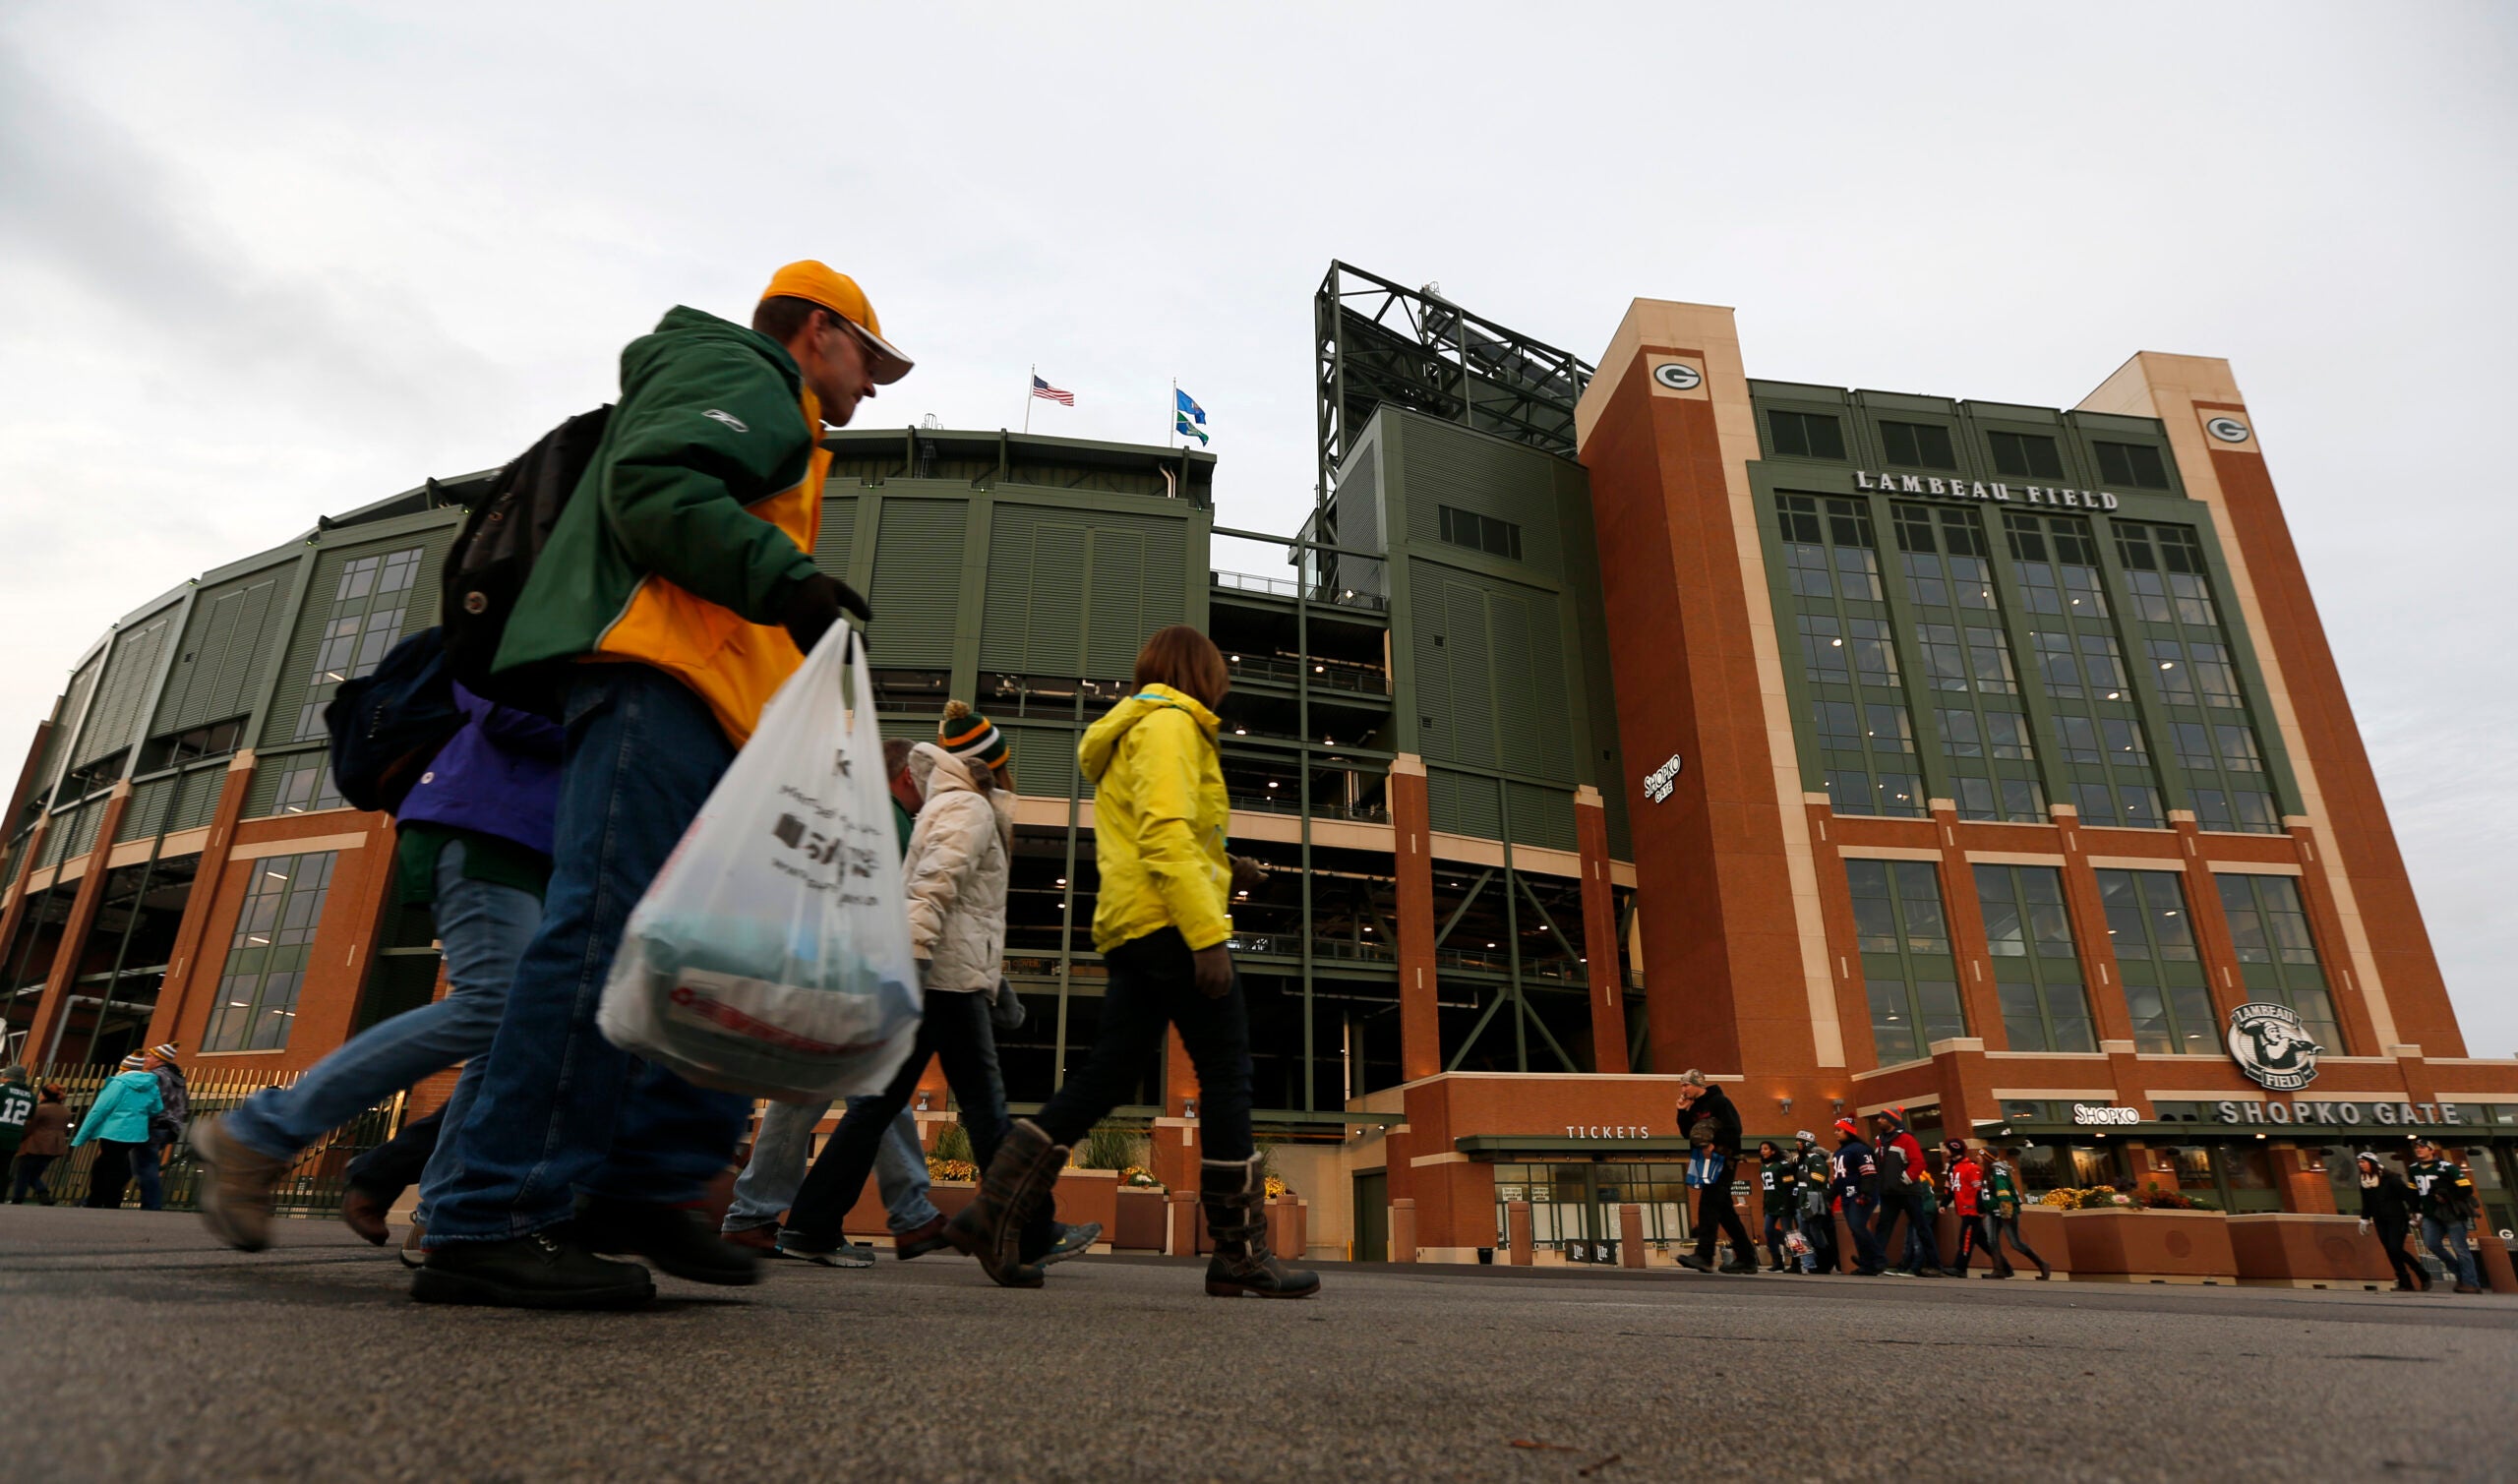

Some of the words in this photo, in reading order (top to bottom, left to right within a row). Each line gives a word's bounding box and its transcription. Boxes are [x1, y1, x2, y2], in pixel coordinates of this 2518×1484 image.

[1855, 470, 2010, 501] LAMBEAU
[2026, 486, 2120, 509] FIELD
[1645, 753, 1681, 798] SHOPKO
[1654, 780, 1674, 803] GATE
[2236, 1005, 2294, 1023] LAMBEAU
[2265, 1073, 2303, 1088] FIELD
[0, 1098, 31, 1126] 12
[2073, 1102, 2140, 1125] SHOPKO
[2218, 1100, 2361, 1125] SHOPKO
[2372, 1101, 2462, 1125] GATE
[1566, 1126, 1649, 1139] TICKETS
[1761, 1171, 1775, 1191] 12
[1596, 1245, 1608, 1261] Lite
